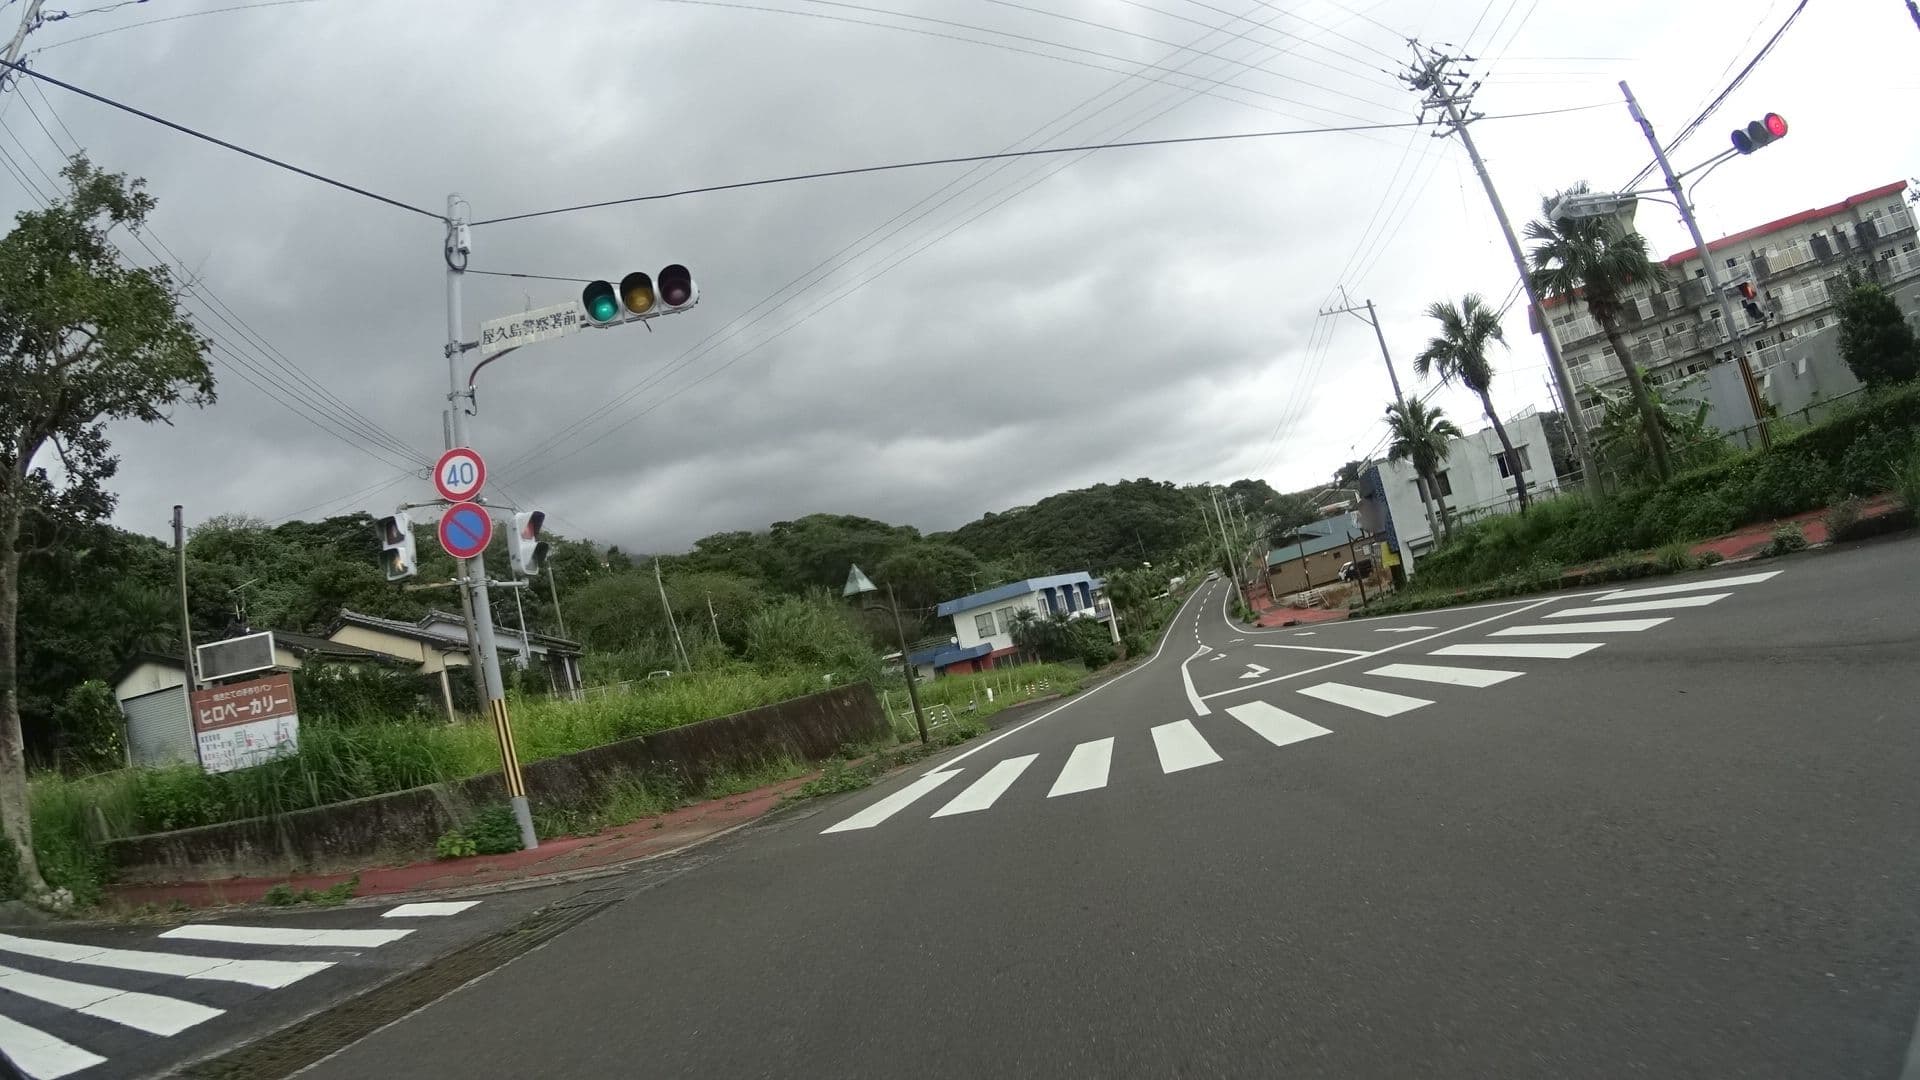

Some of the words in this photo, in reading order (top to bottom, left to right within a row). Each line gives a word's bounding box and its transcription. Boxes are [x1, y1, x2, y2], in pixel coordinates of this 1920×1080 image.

[482, 310, 577, 345] 屋久島警察署前
[447, 462, 474, 487] 40
[200, 695, 288, 724] ヒロベーカリー
